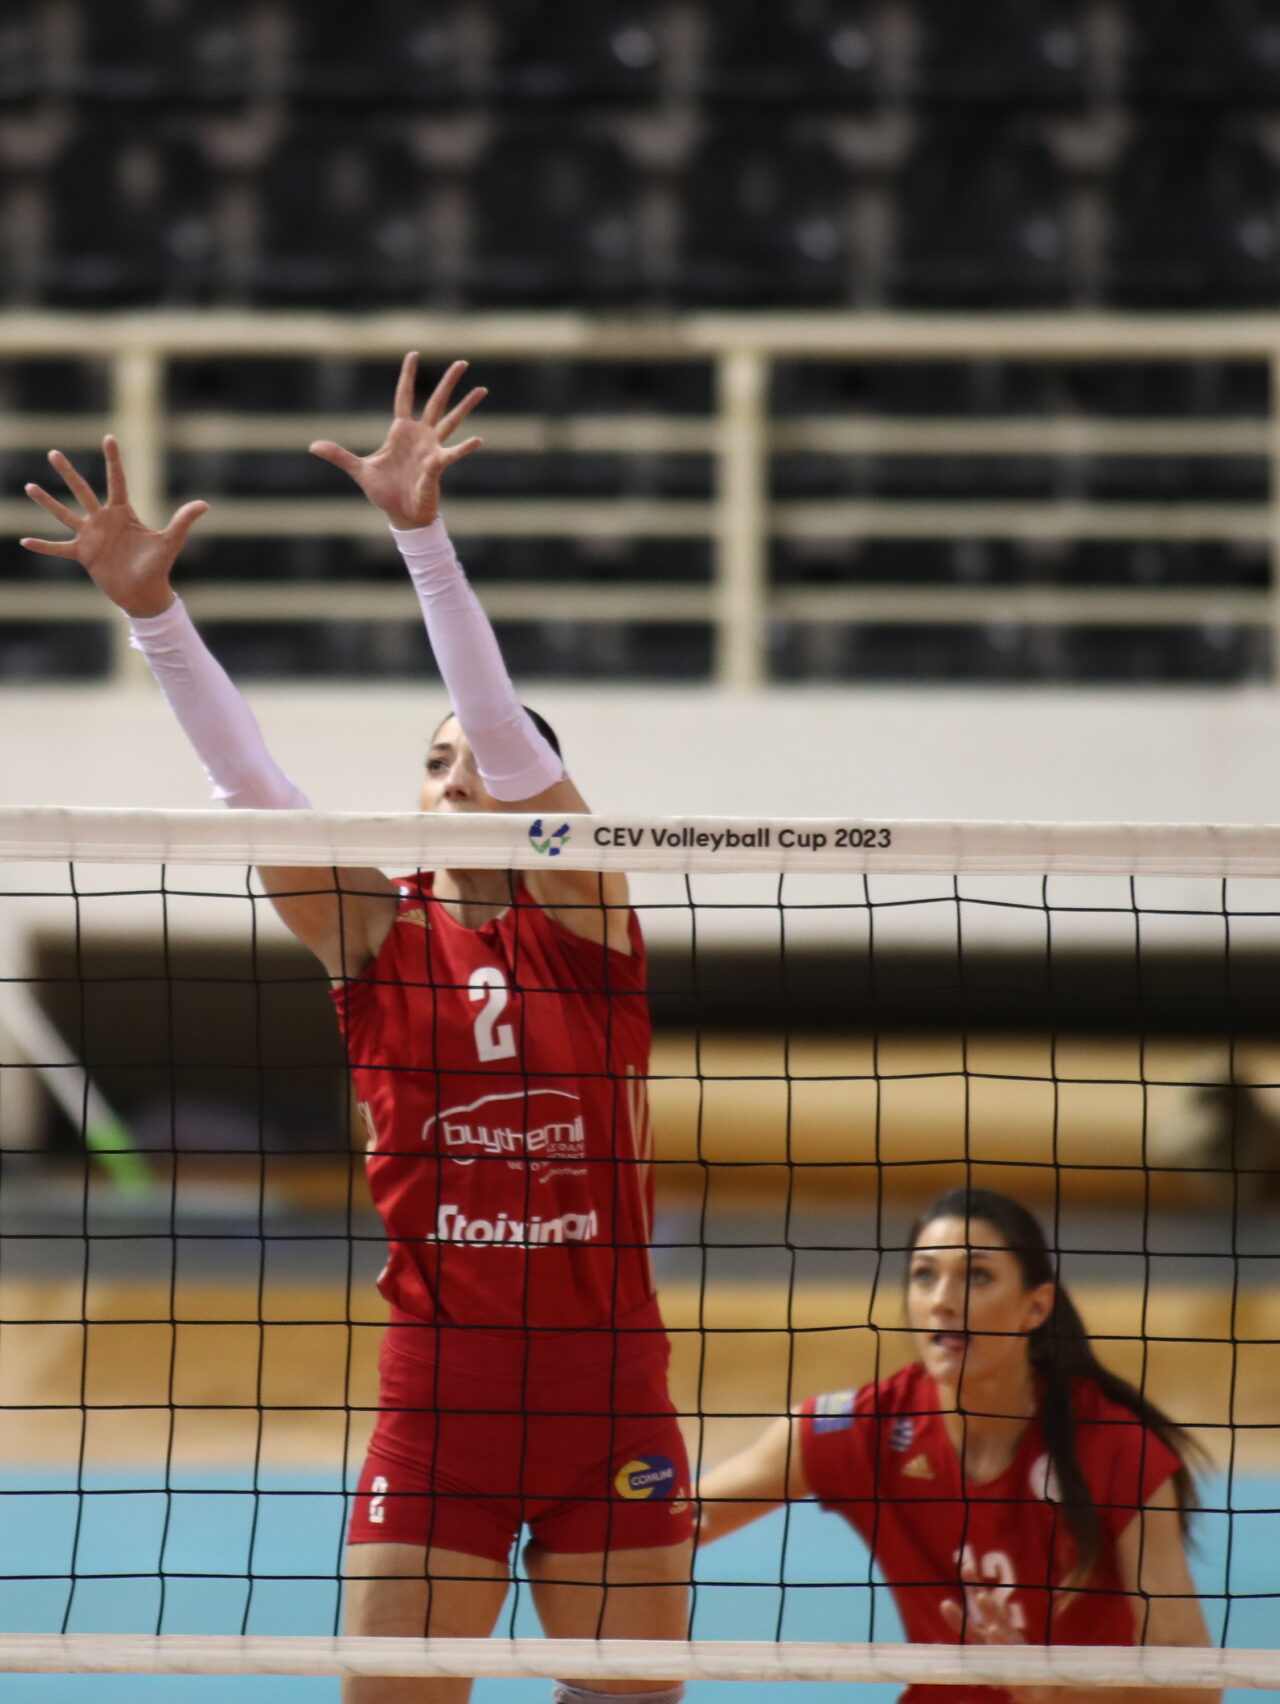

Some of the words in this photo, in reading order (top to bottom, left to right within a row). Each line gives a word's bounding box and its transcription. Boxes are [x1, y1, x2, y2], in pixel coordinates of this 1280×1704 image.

[593, 826, 644, 847] CEV
[651, 826, 770, 852] Volleyball
[778, 827, 827, 852] Cup
[834, 828, 892, 849] 2023
[467, 966, 516, 1063] 2
[369, 1476, 388, 1524] 2
